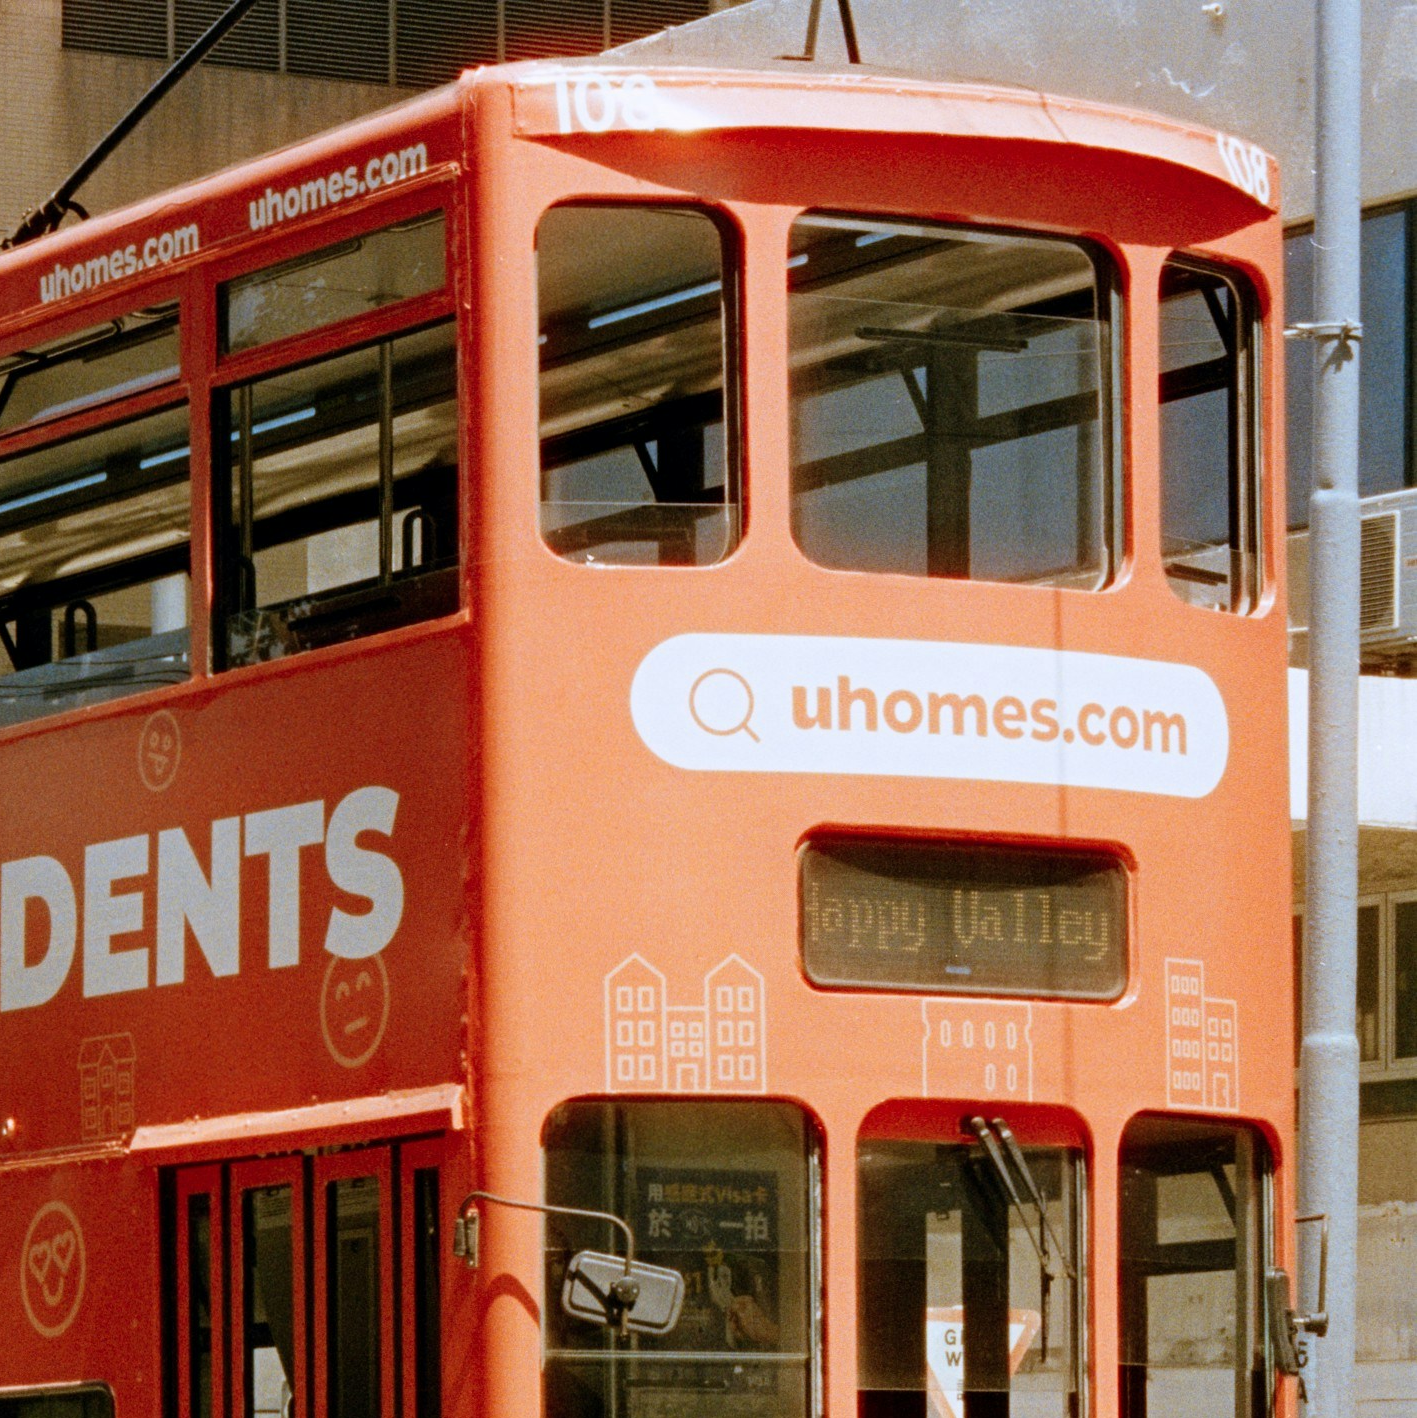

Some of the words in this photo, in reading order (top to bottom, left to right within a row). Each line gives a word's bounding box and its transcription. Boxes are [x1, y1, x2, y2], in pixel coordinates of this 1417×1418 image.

[556, 73, 655, 134] 108
[249, 142, 427, 232] uhomes.com
[1216, 131, 1269, 206] 108
[40, 223, 199, 303] uhomes.com
[791, 675, 1188, 756] uhomes.com
[953, 889, 1108, 960] Valley
